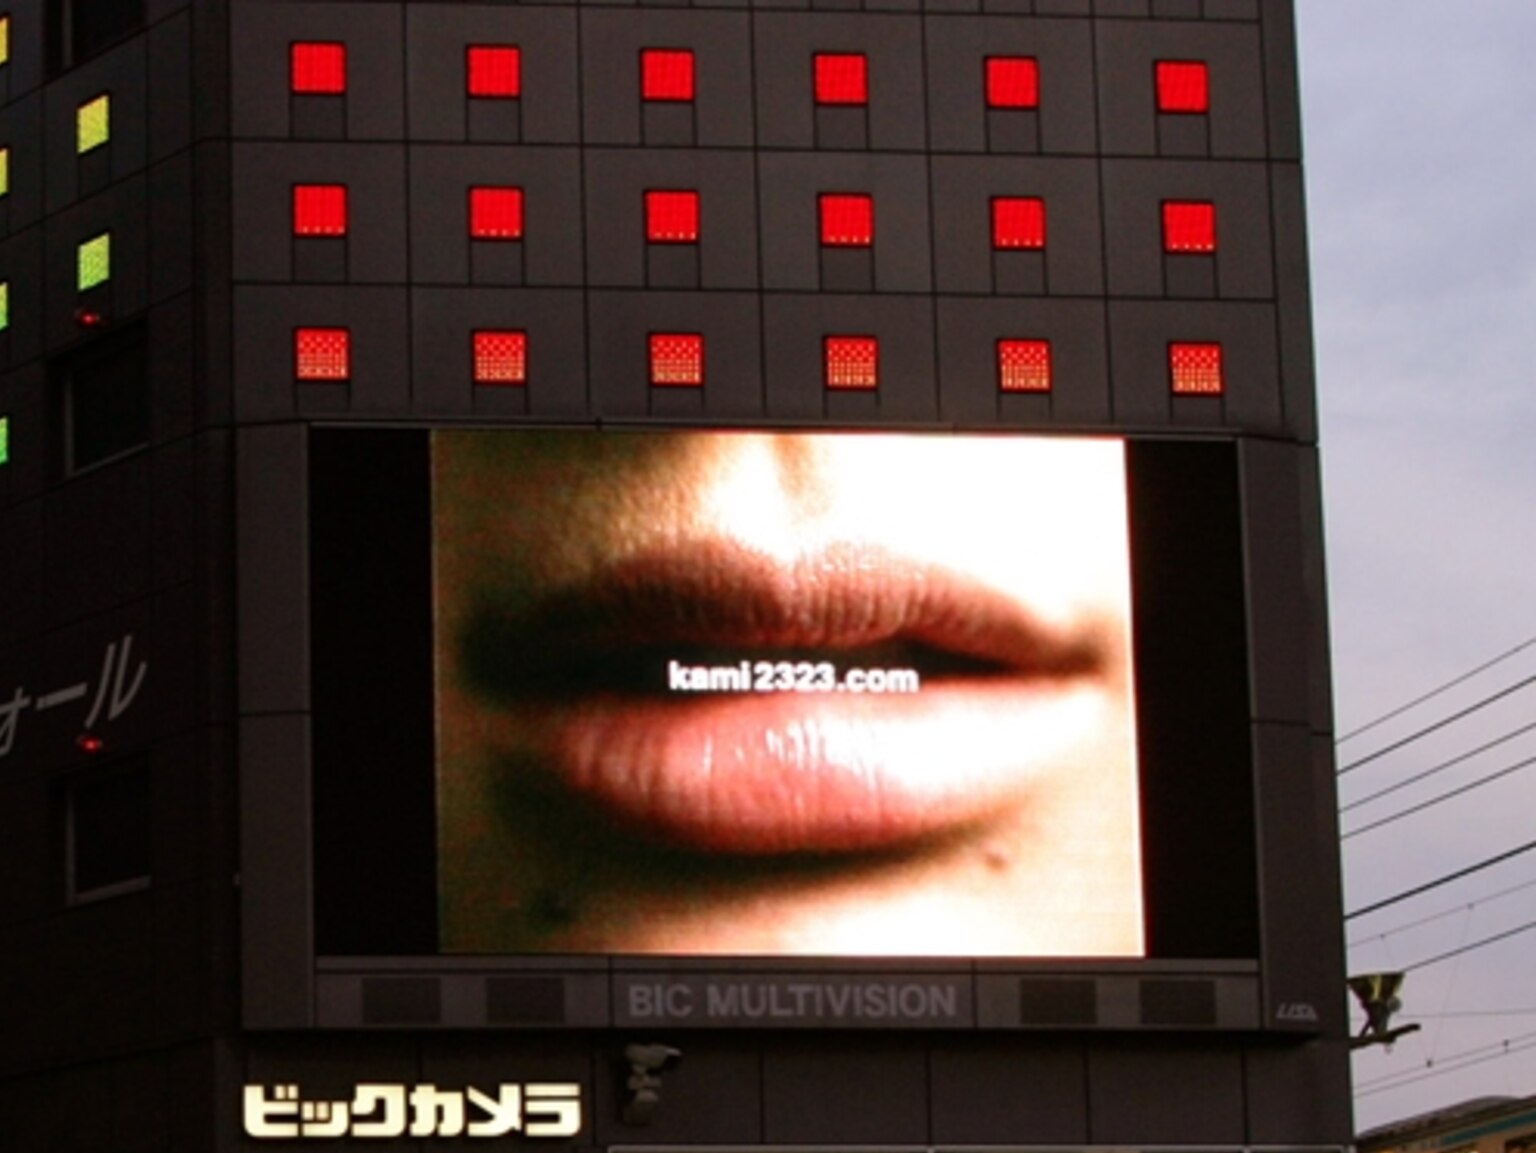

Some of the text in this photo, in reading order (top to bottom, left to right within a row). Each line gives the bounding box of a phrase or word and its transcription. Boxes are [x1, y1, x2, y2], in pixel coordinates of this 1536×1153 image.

[668, 660, 920, 692] kami2323.com
[628, 985, 957, 1018] BIC MULTIVISION
[242, 1083, 582, 1138] ビックカメラ
